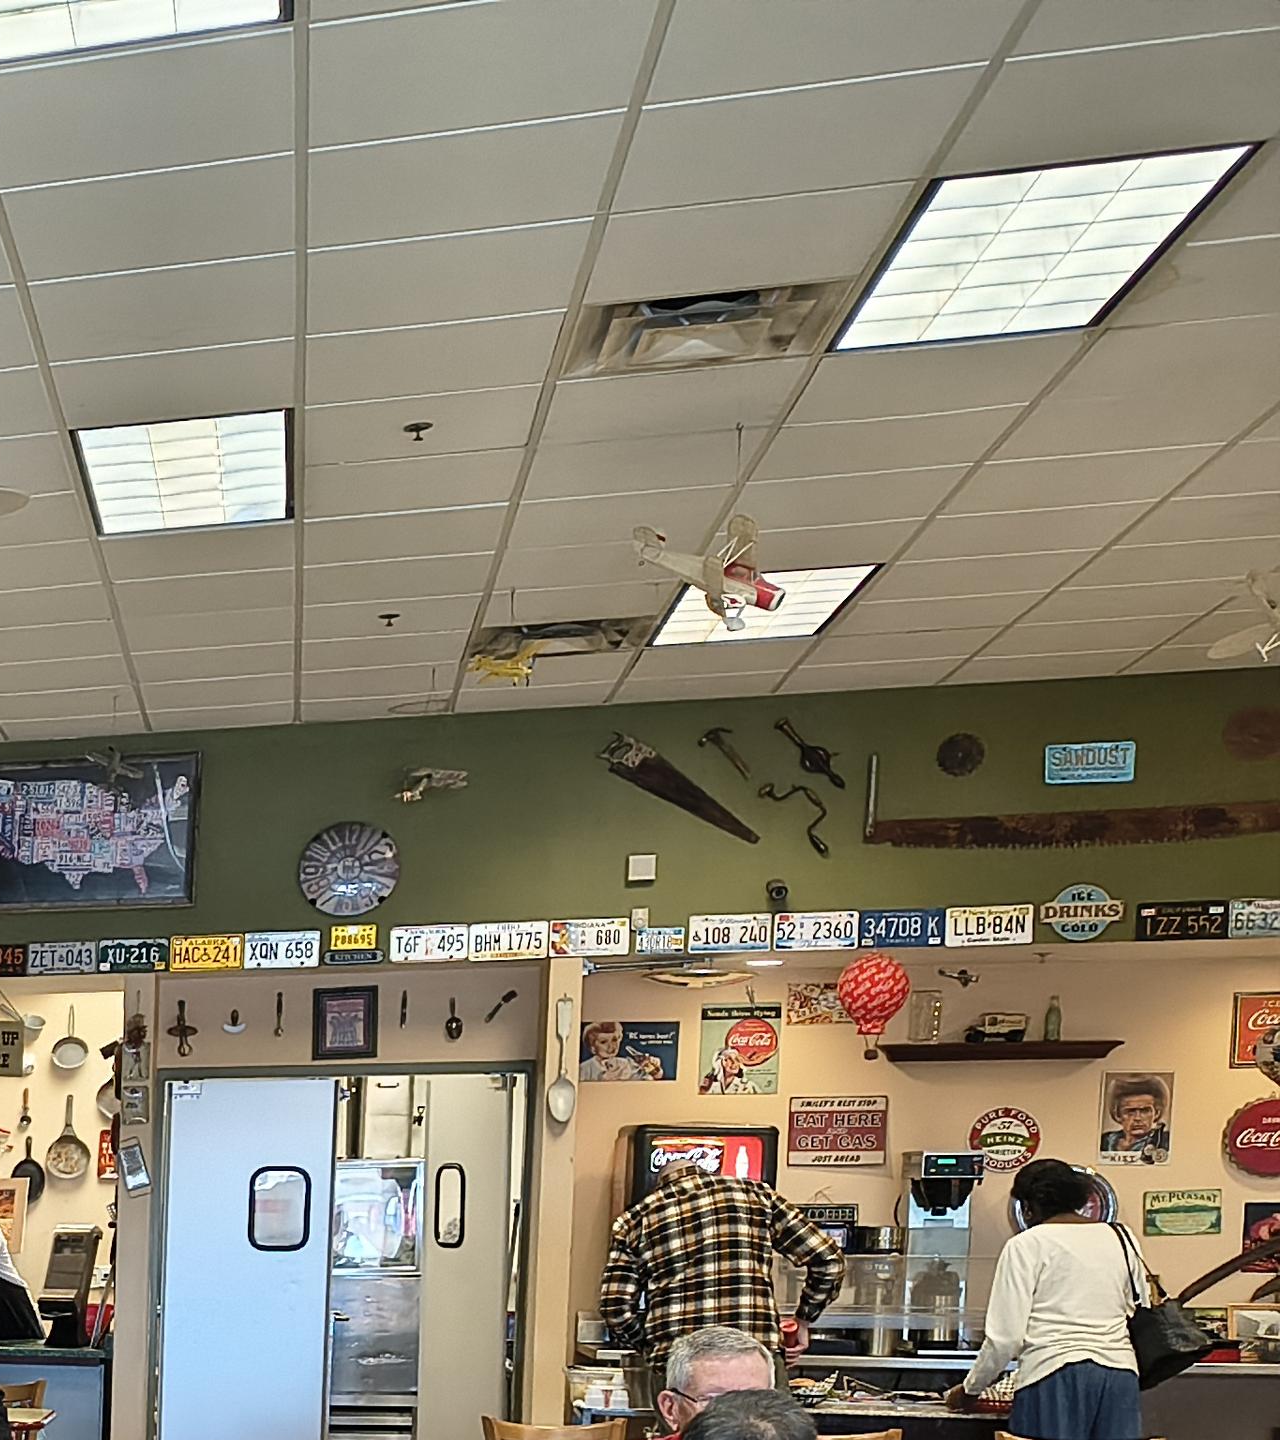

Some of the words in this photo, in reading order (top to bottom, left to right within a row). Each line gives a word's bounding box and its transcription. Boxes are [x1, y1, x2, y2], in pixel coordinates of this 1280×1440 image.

[1051, 746, 1131, 769] SAWDUST
[1044, 904, 1120, 919] DRINKS
[777, 922, 796, 941] 52
[812, 920, 854, 940] 2360
[864, 916, 922, 938] 34708
[927, 916, 940, 937] K
[954, 916, 986, 936] LLB
[992, 914, 1025, 934] 84N
[1061, 923, 1099, 933] COLD
[1188, 915, 1222, 934] 552
[396, 935, 422, 953] T6F
[437, 933, 465, 952] 495
[507, 931, 543, 951] 1775
[596, 929, 621, 946] 680
[702, 927, 731, 945] 108
[738, 926, 768, 944] 240
[31, 950, 58, 968] ZET
[65, 949, 93, 967] 043
[173, 946, 201, 964] HAC
[212, 945, 238, 963] 241
[285, 941, 314, 959] 658
[334, 953, 373, 961] KITCHEN
[2, 1031, 20, 1046] UP
[728, 1031, 775, 1048] Coca-Cola
[794, 1112, 828, 1127] EAT
[834, 1111, 882, 1127] HERE
[975, 1109, 1004, 1130] PURE
[1009, 1108, 1038, 1135] FOOD
[997, 1121, 1013, 1130] 57
[797, 1134, 833, 1150] GET
[838, 1134, 877, 1150] GAS
[986, 1135, 1023, 1145] HEINZ
[811, 1154, 832, 1163] JUST
[1168, 1192, 1218, 1204] PLEASANT
